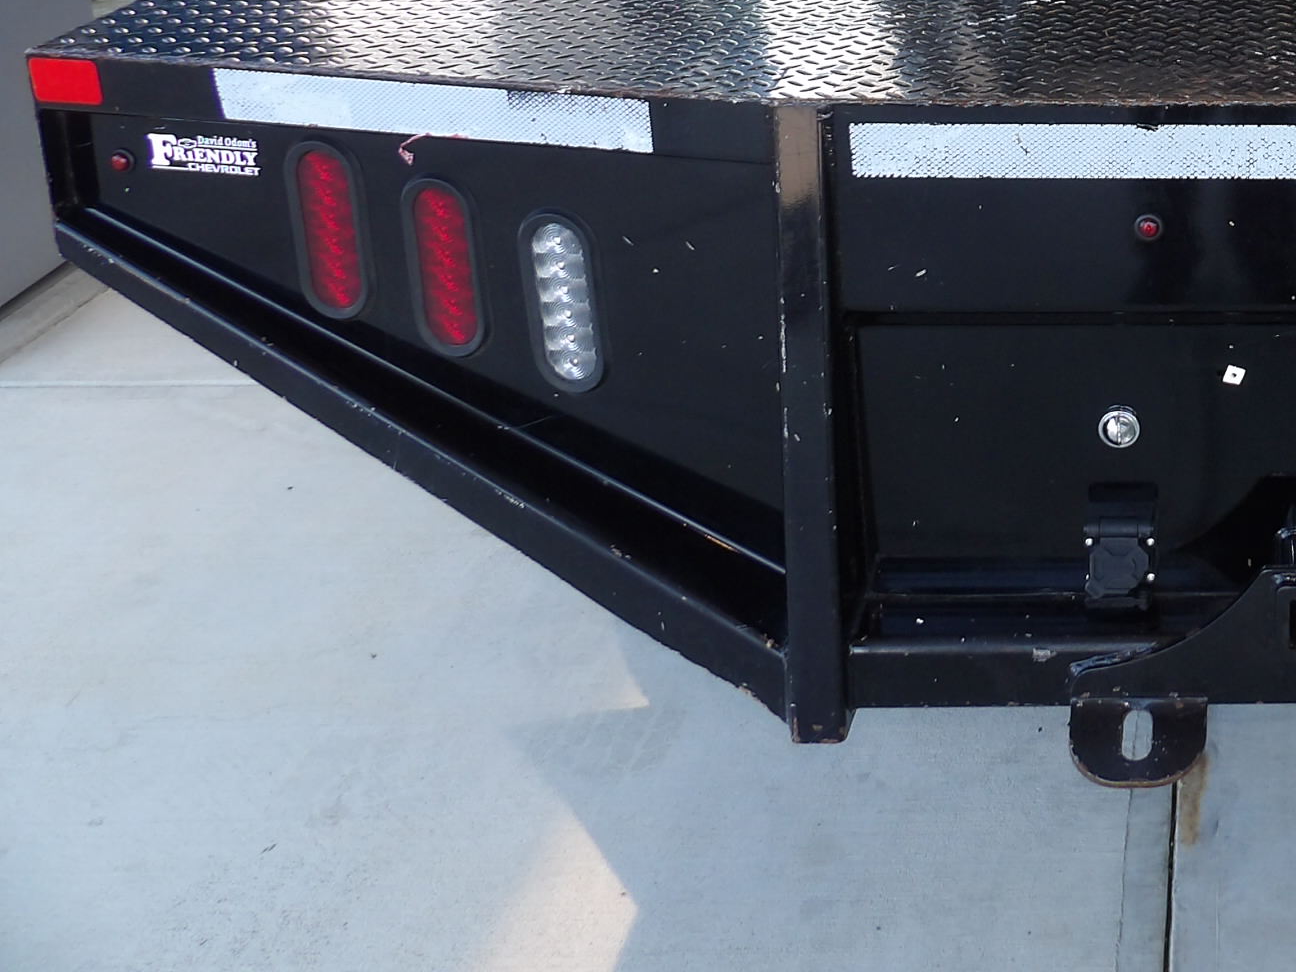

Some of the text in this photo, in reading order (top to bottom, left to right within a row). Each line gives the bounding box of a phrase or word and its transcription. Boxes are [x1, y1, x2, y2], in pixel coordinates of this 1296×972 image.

[197, 135, 257, 148] David Odom's
[188, 162, 261, 176] CHEVROLET
